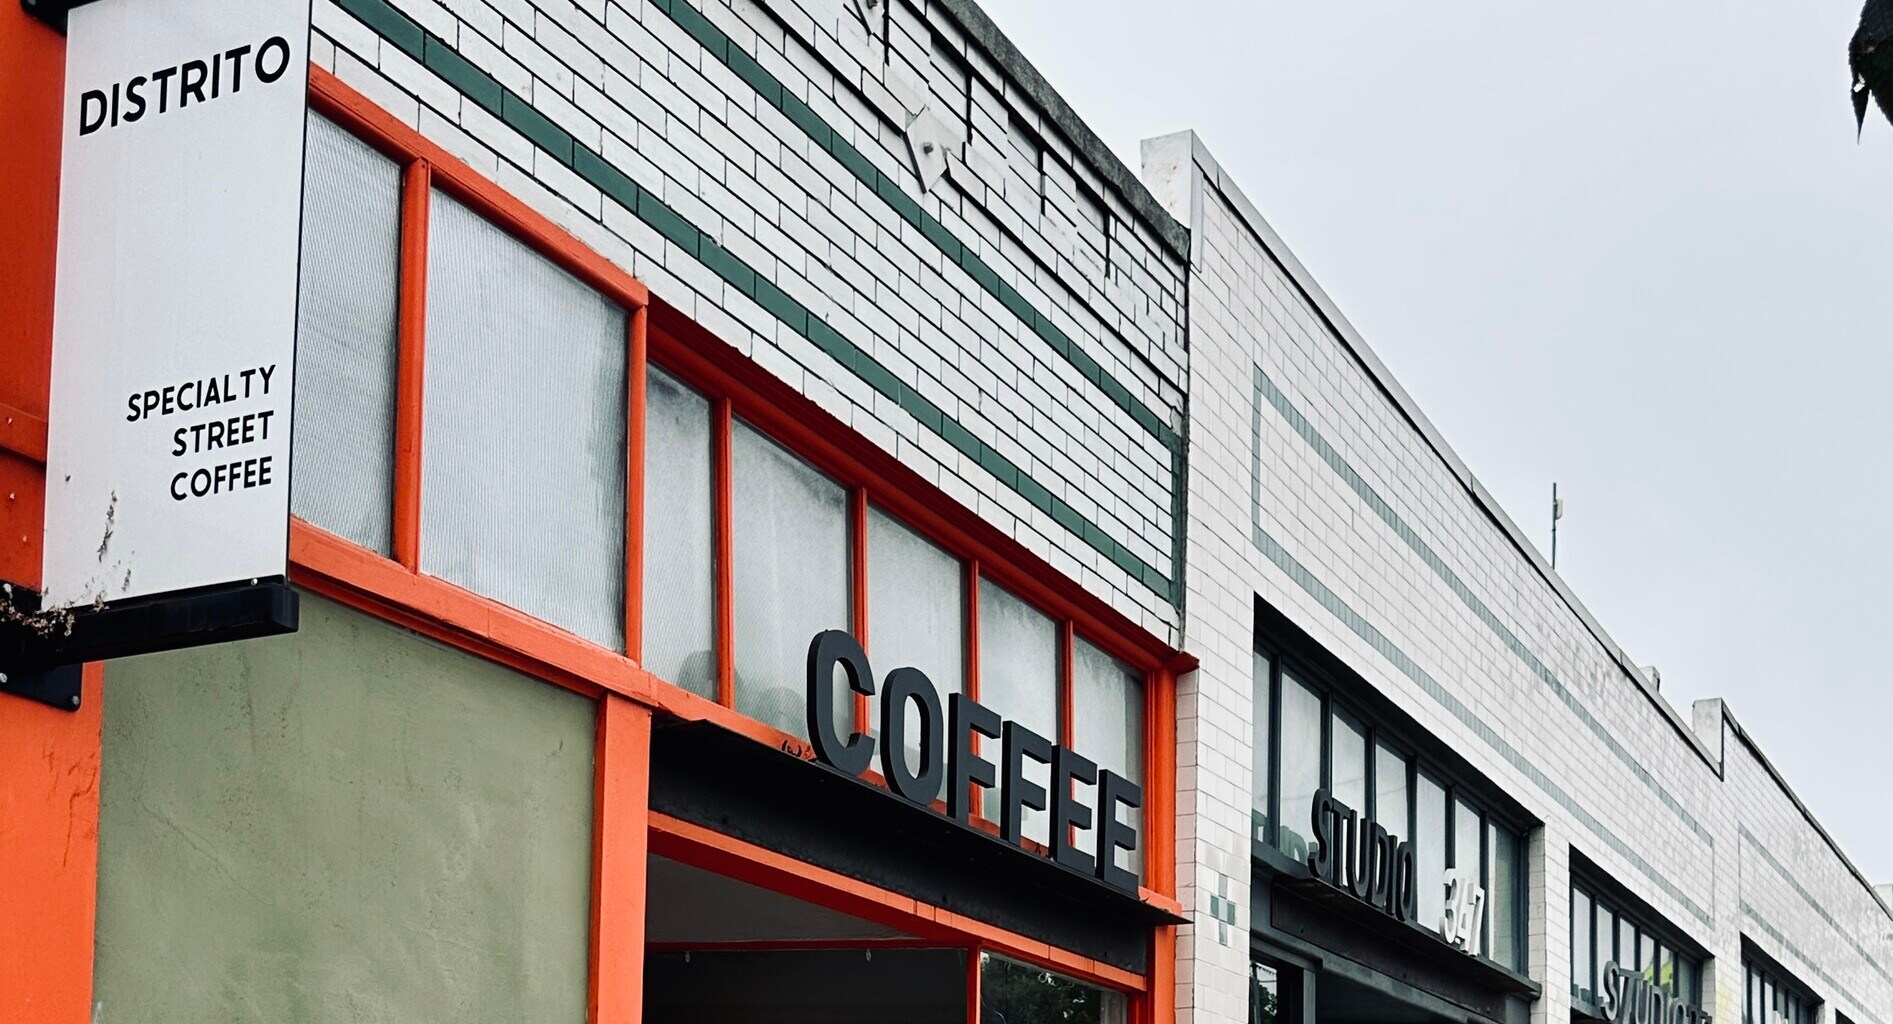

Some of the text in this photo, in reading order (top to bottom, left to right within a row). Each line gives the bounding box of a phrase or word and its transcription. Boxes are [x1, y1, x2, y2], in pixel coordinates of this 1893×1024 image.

[79, 35, 290, 136] DISTRITO
[126, 364, 276, 422] SPECIALTY
[171, 410, 274, 457] STREET
[170, 456, 273, 501] COFFEE
[806, 629, 1142, 898] COFFEE
[1307, 788, 1485, 957] STUDIO 347
